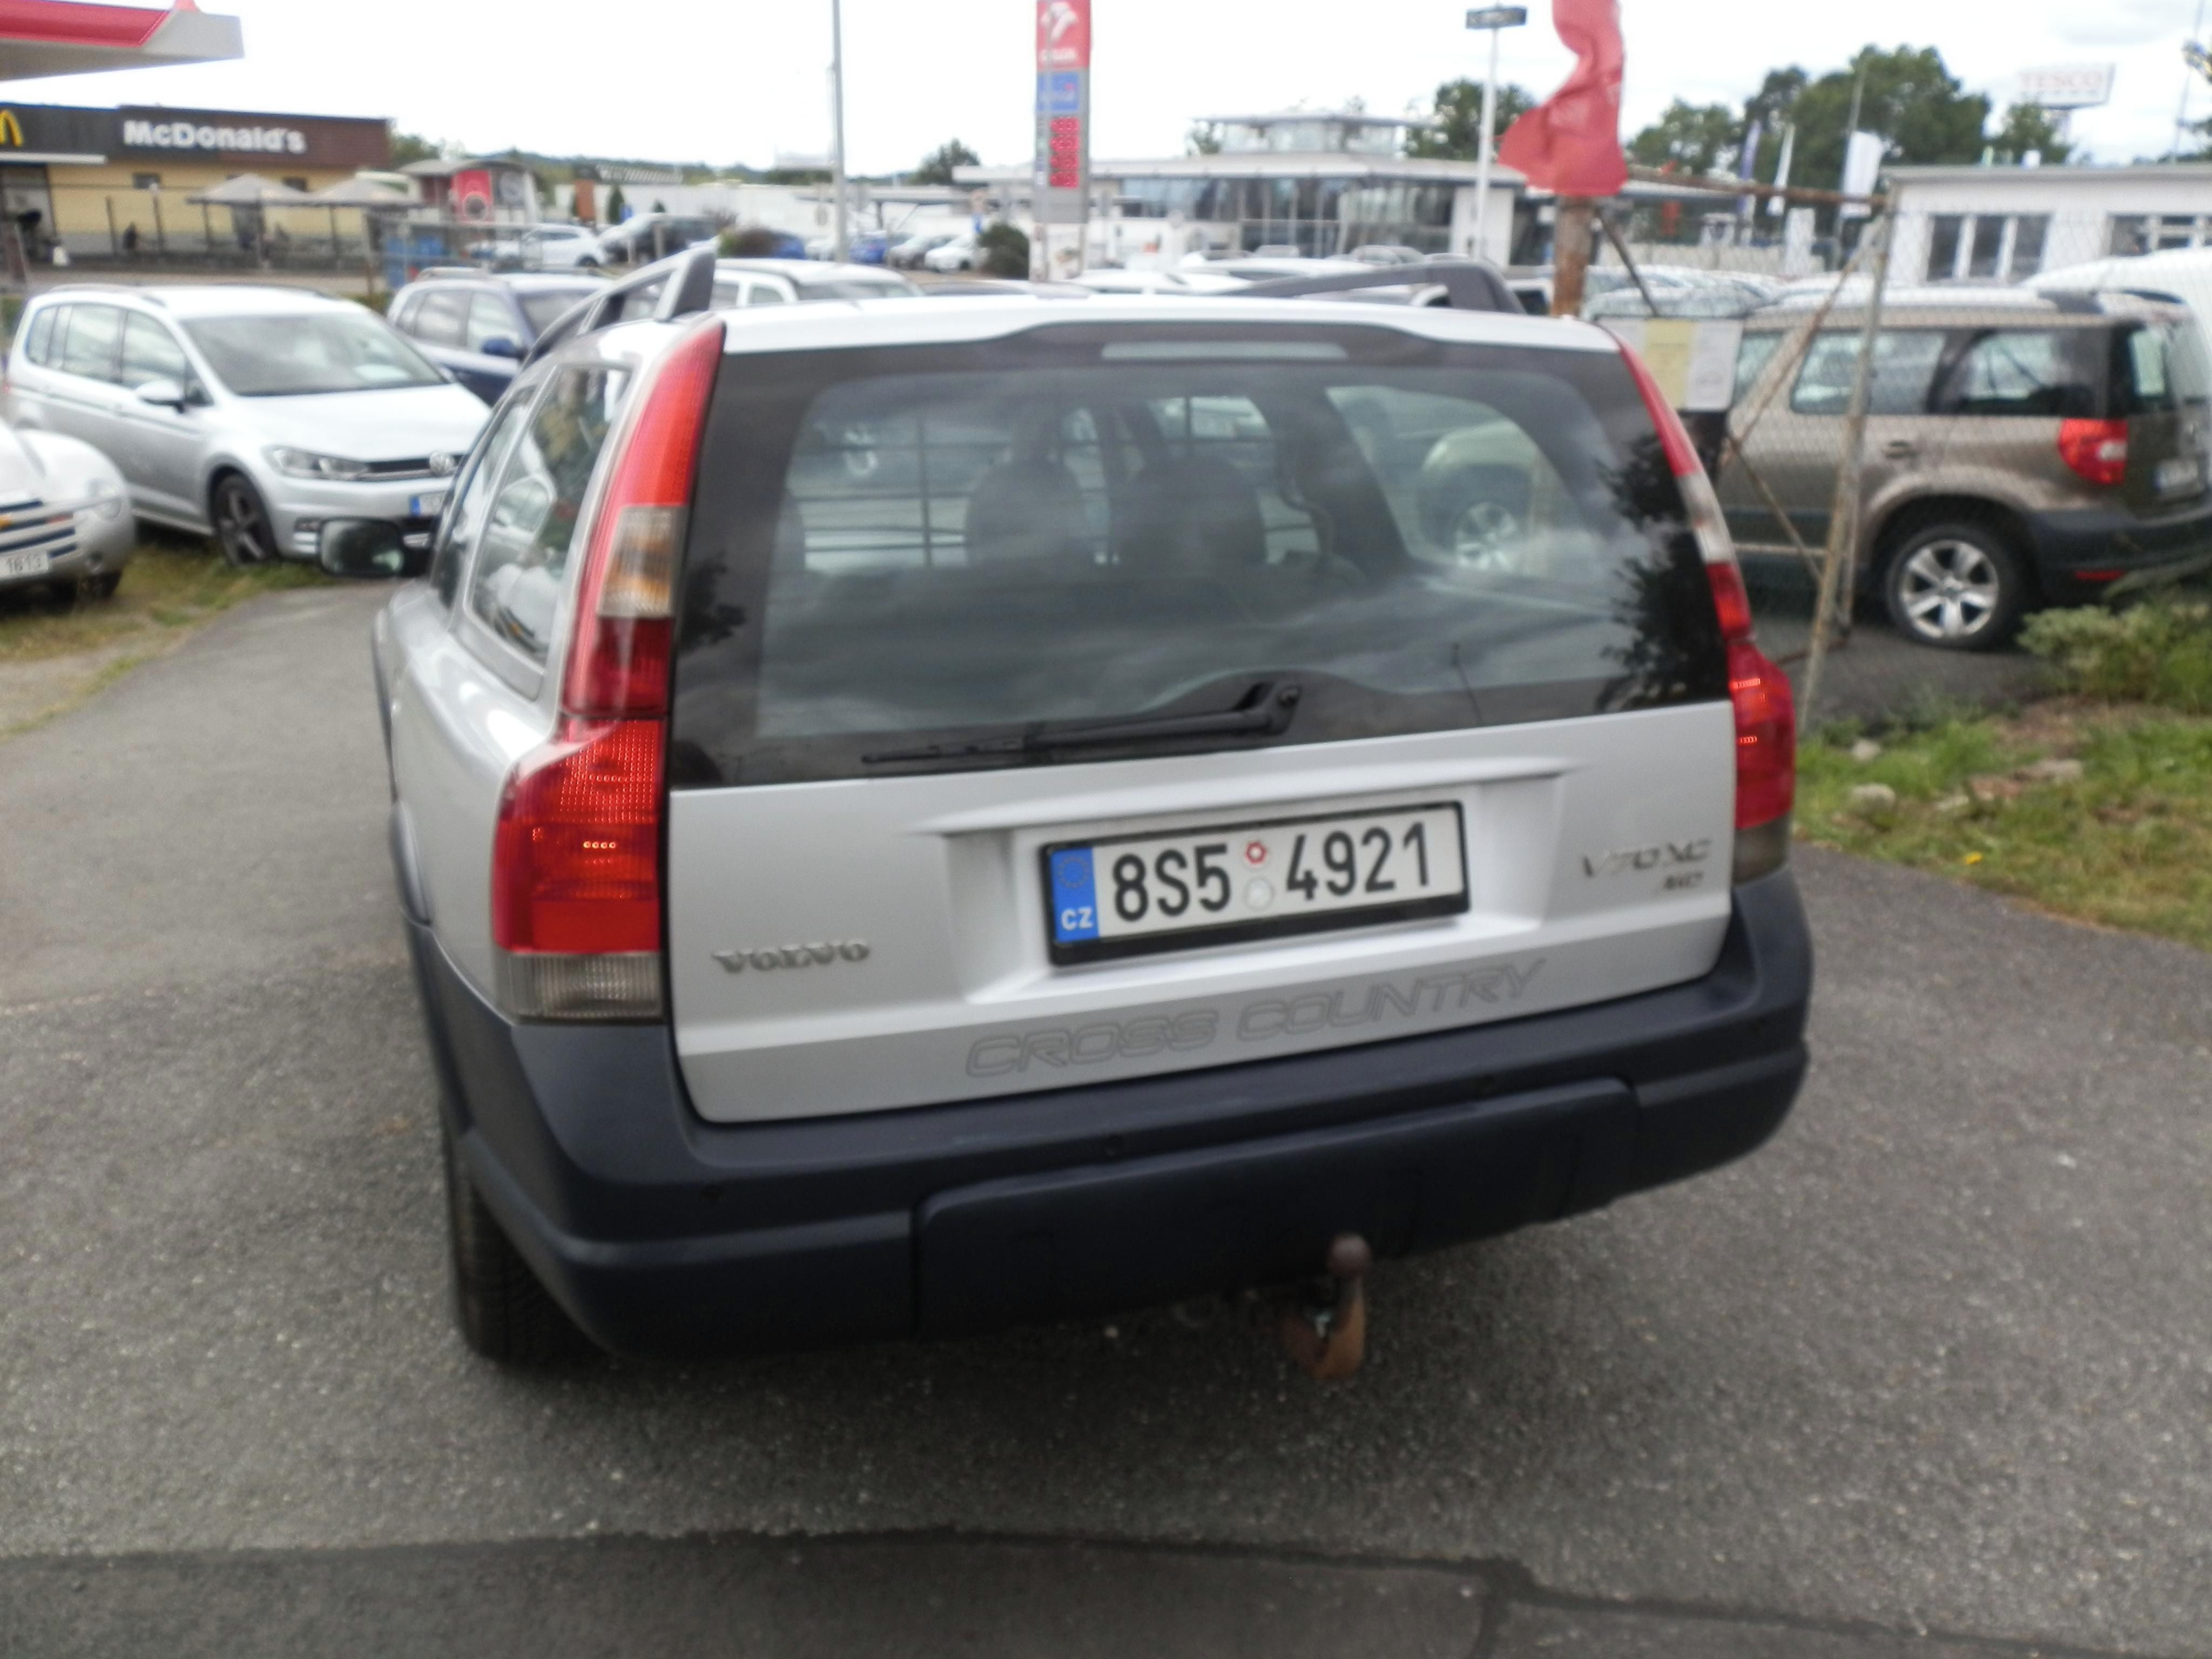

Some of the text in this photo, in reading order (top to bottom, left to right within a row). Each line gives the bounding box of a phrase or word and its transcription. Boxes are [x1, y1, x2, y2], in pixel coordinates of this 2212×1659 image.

[124, 120, 307, 154] McDonald's
[1112, 821, 1429, 923] 8S5 4921
[1061, 907, 1093, 931] CZ
[711, 942, 871, 974] VOLVO
[965, 957, 1548, 1078] CROSS COUNTRY
